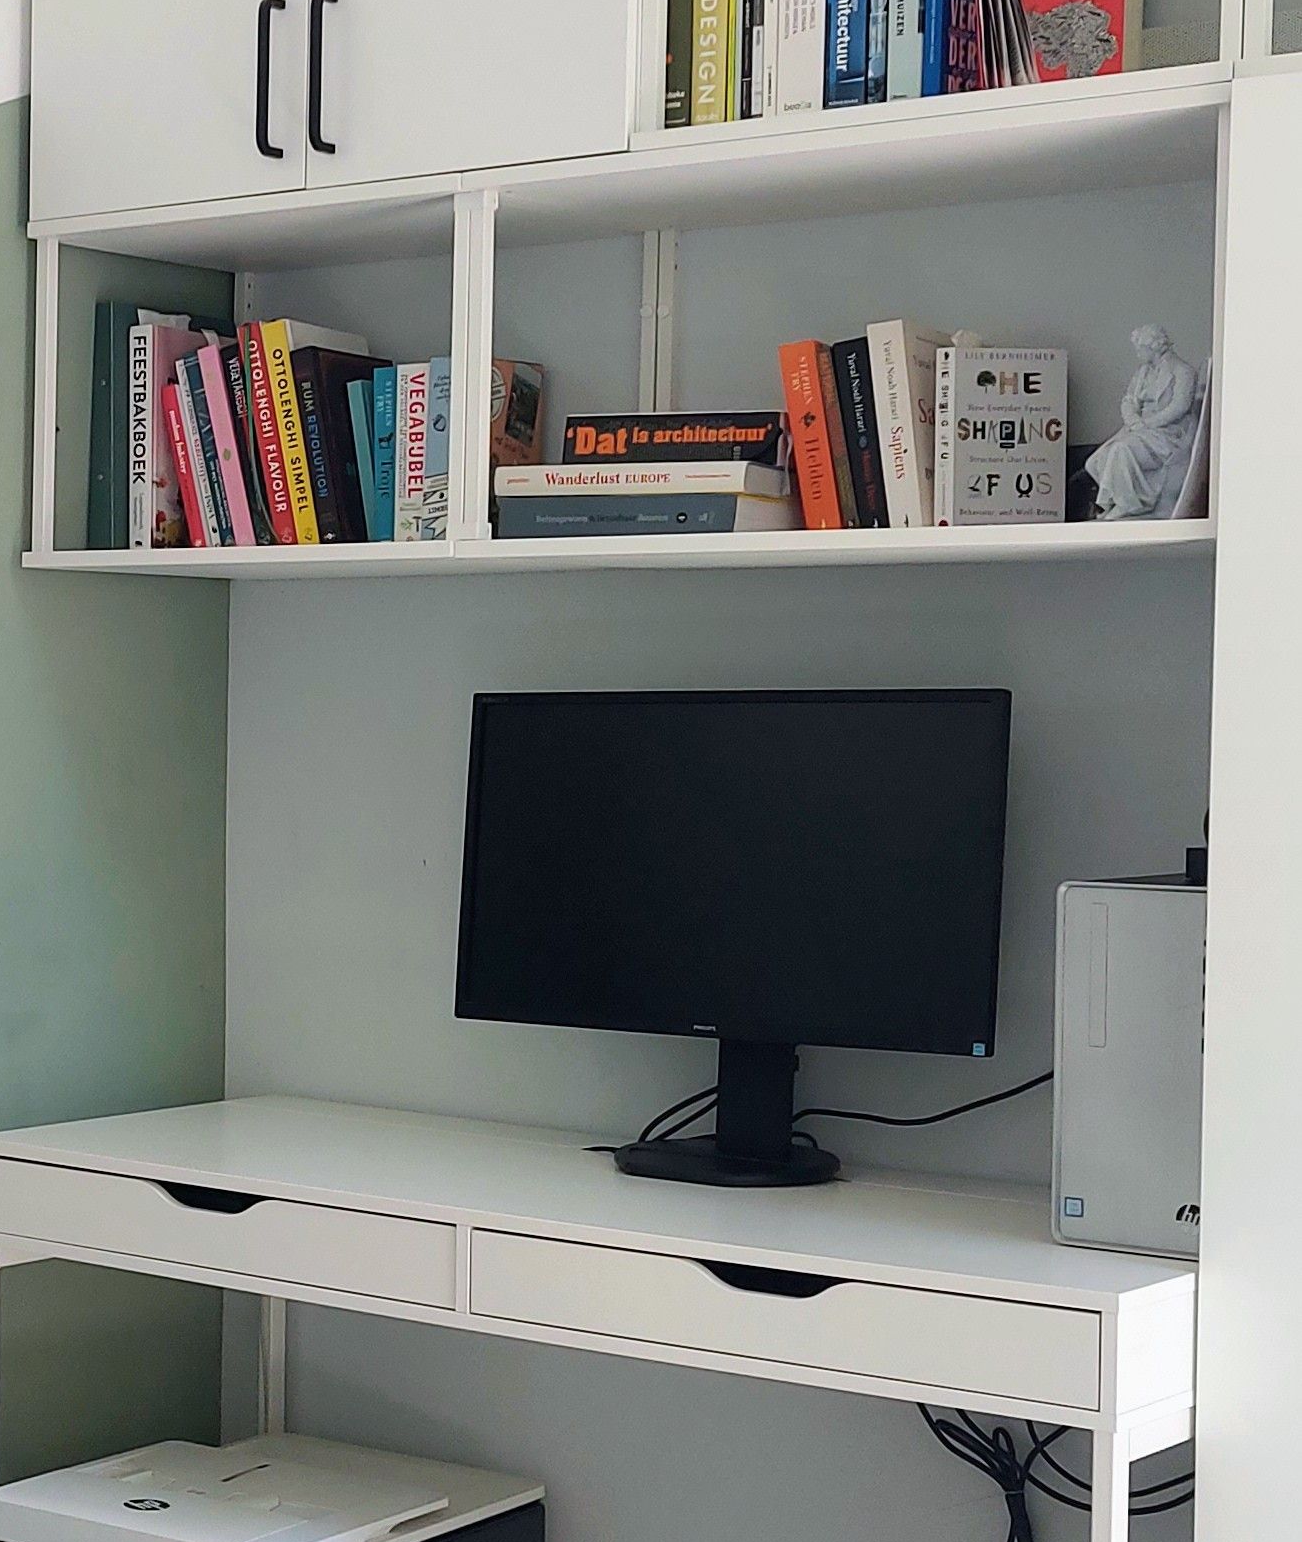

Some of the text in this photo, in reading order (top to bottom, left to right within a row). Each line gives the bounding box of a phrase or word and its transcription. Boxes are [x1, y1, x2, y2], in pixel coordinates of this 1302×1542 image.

[846, 352, 857, 379] Yuval
[132, 335, 147, 484] FEESTBAKBOEK
[850, 378, 862, 404] Noah
[248, 339, 287, 513] OTTOLENGHI FLAVOUR
[273, 348, 308, 514] OTTOLENGHI SIMPEL
[301, 381, 328, 498] RUM REVOLUTION
[853, 404, 867, 433] Harari
[804, 437, 823, 500] Helden
[888, 426, 908, 480] Sapiens
[378, 456, 393, 499] Troje
[545, 471, 620, 487] Wanderlust
[625, 472, 671, 485] EUROPE
[1015, 473, 1053, 498] US
